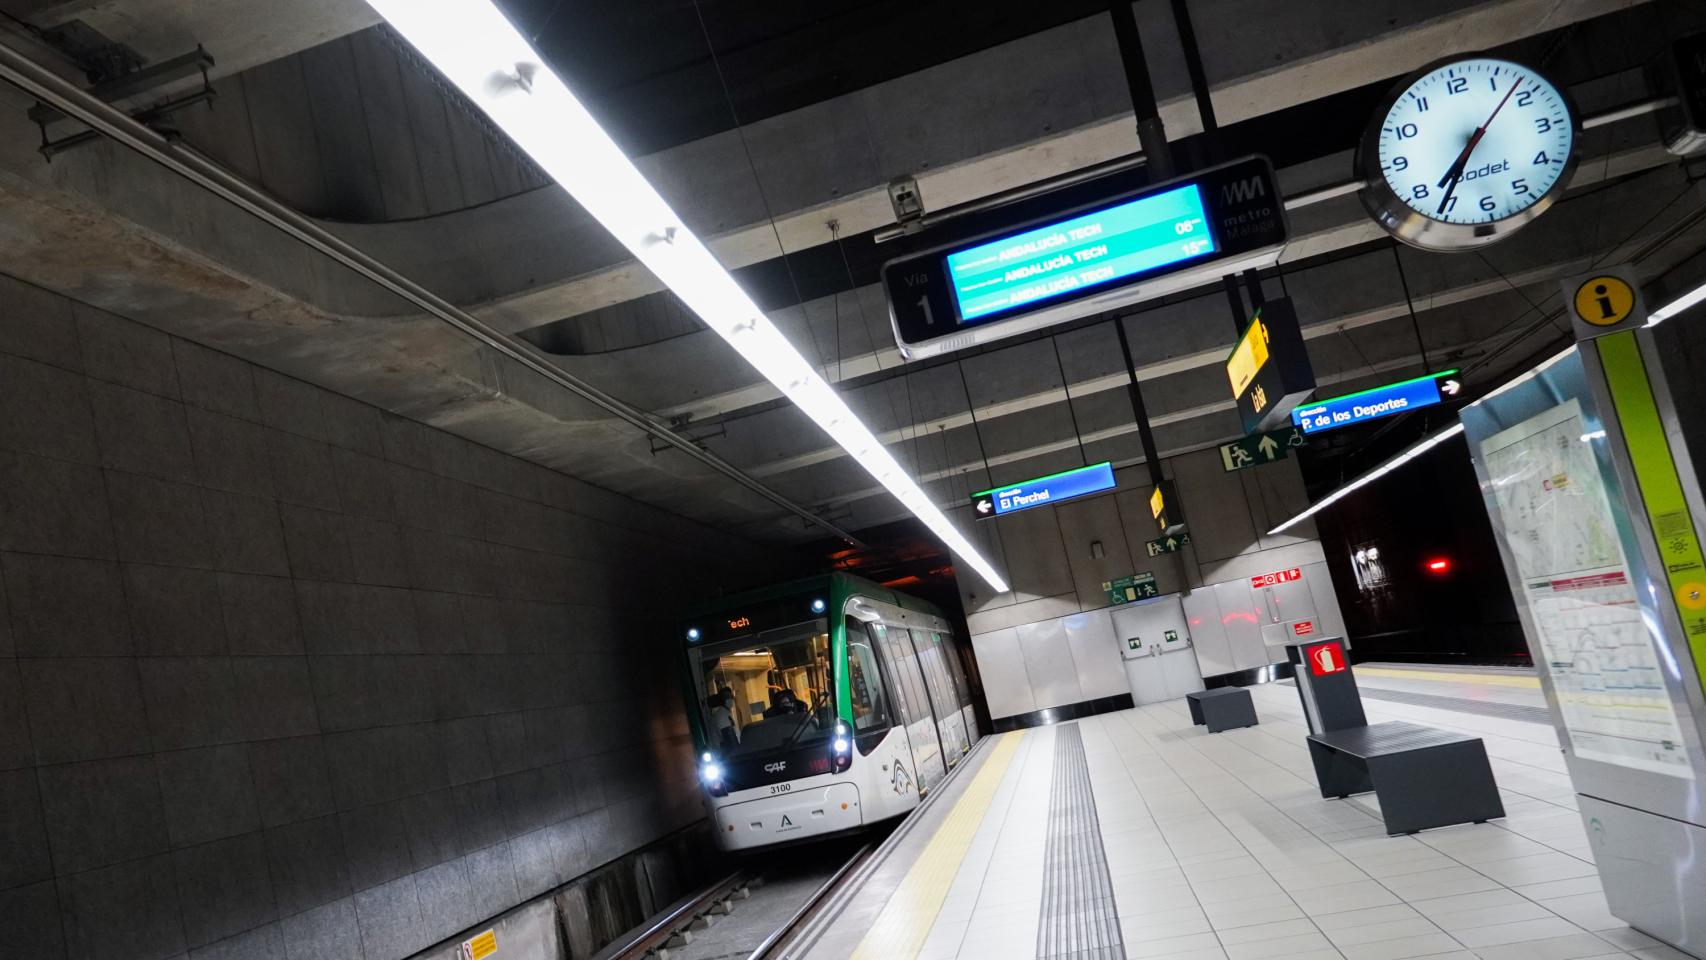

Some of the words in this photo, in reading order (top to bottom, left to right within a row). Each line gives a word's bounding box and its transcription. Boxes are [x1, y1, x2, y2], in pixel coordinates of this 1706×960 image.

[1447, 77, 1469, 95] 12
[1490, 77, 1497, 91] 1
[1416, 97, 1429, 112] 11
[1515, 90, 1534, 107] 2
[1396, 123, 1418, 140] 10
[1535, 117, 1551, 133] 3
[1393, 156, 1408, 171] 9
[1533, 151, 1550, 166] 4
[1413, 184, 1429, 199] 8
[1512, 178, 1529, 195] 5
[1480, 195, 1496, 211] 6
[1223, 207, 1271, 228] metro
[999, 232, 1067, 261] ANDALUCÍA
[1068, 223, 1102, 241] TECH
[1004, 253, 1074, 283] ANDALUCÍA
[1074, 244, 1108, 262] TECH
[1010, 275, 1078, 304] ANDALUCÍA
[1079, 265, 1114, 284] TECH
[917, 295, 934, 325] 1
[1301, 418, 1312, 430] P.
[1315, 415, 1331, 427] de
[1332, 410, 1351, 422] los
[1353, 397, 1408, 418] Deportes
[1000, 498, 1011, 509] El
[1013, 489, 1050, 507] Perchel
[728, 617, 750, 629] ech
[764, 761, 786, 773] CAF
[771, 783, 791, 794] 3100
